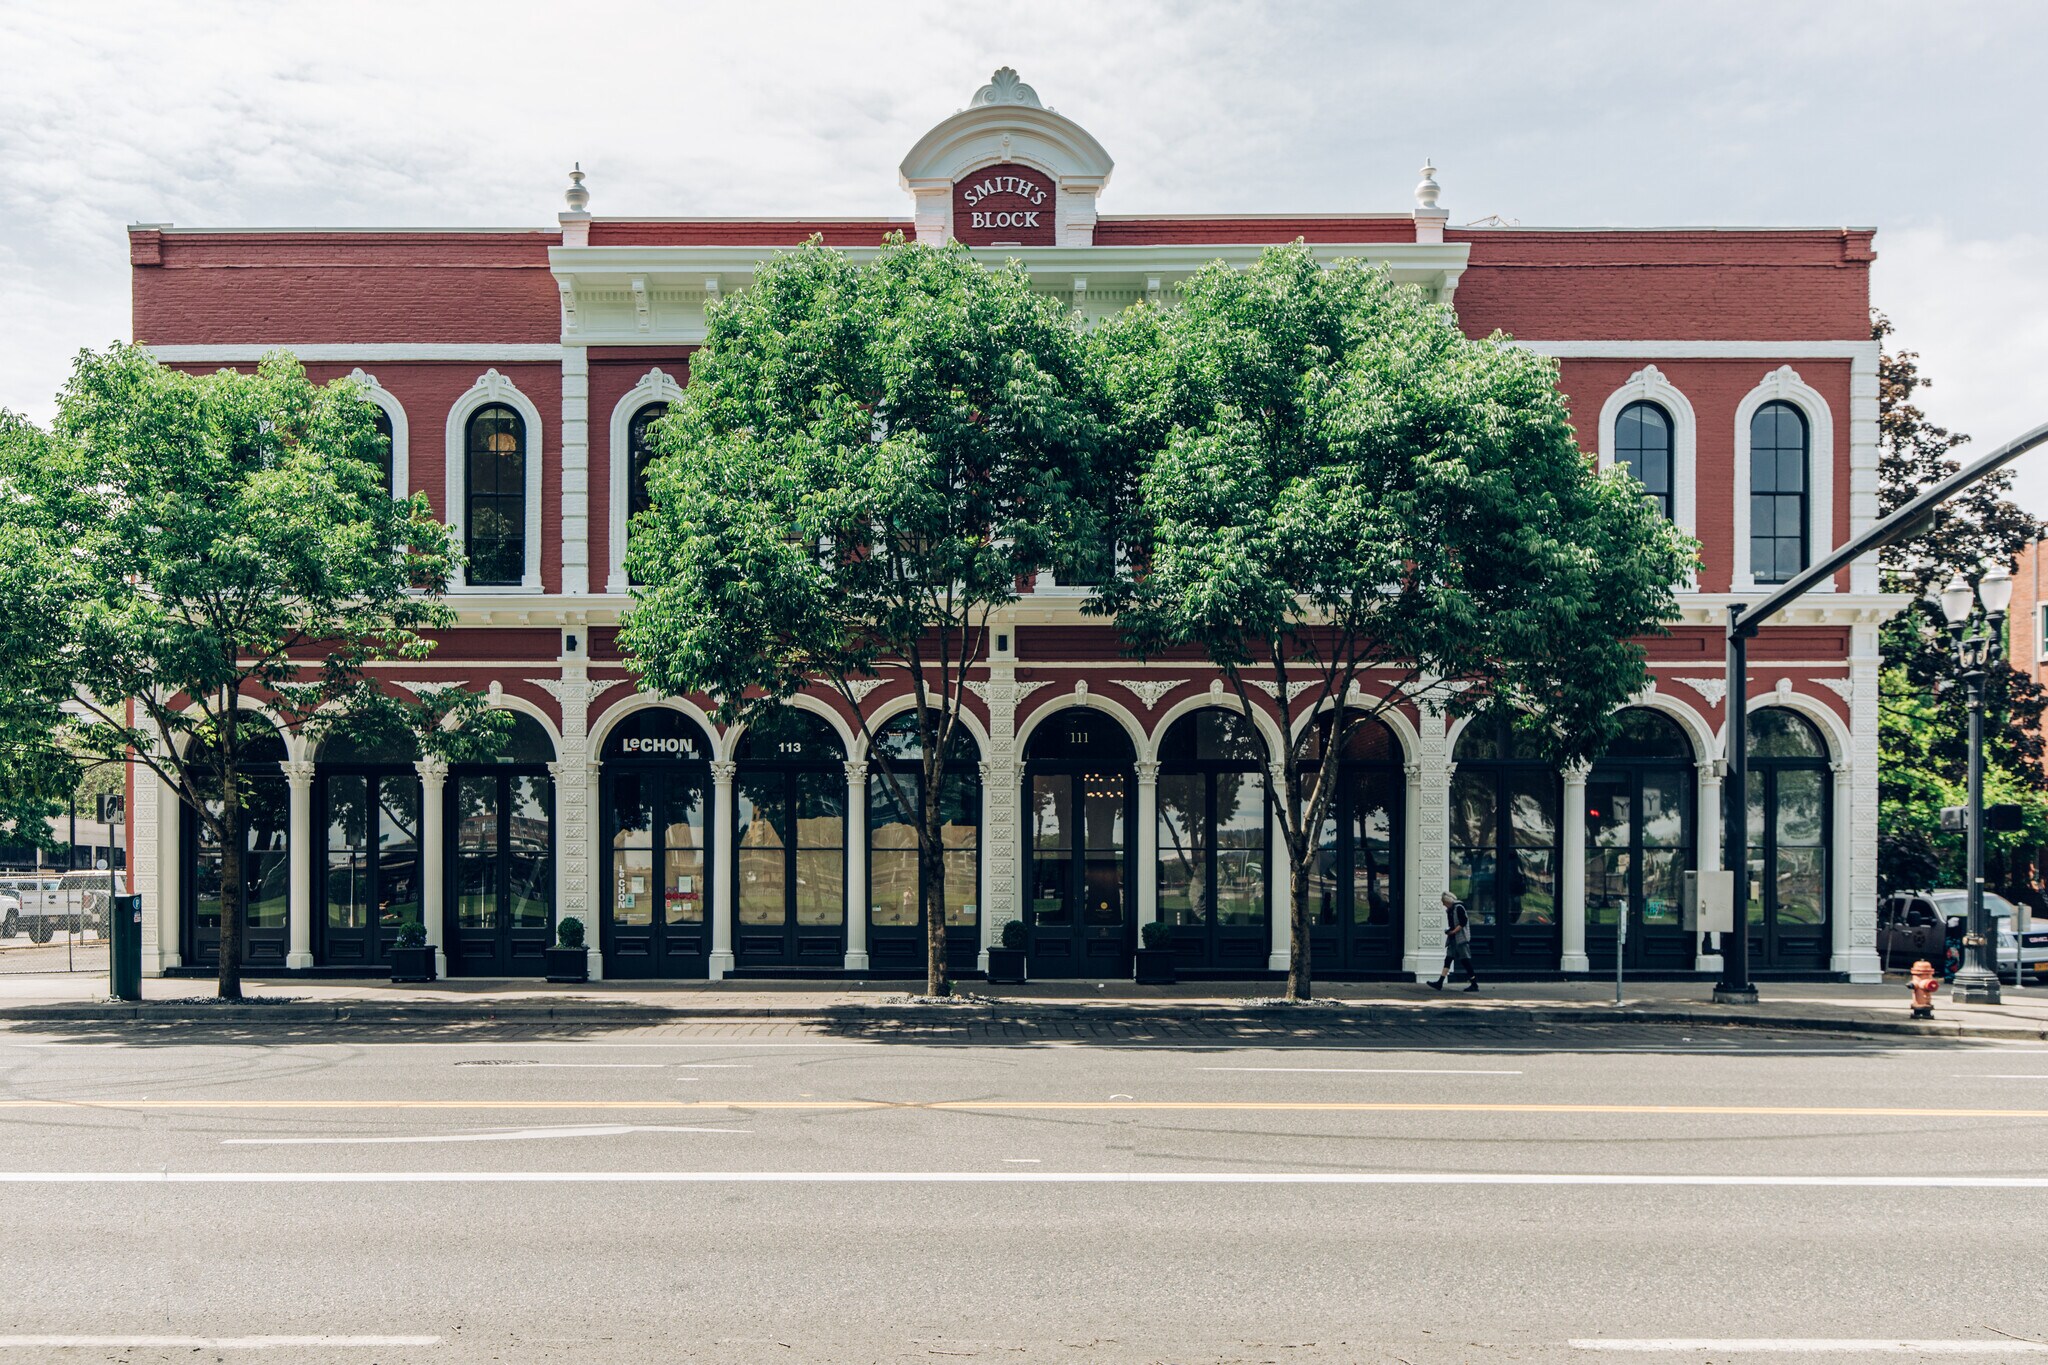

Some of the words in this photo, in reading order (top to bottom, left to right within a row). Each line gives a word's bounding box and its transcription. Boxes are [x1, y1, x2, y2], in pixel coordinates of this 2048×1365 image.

[964, 176, 1047, 207] SMITH'S
[971, 211, 1040, 228] BLOCK
[1070, 732, 1089, 743] 111
[778, 742, 801, 752] 113
